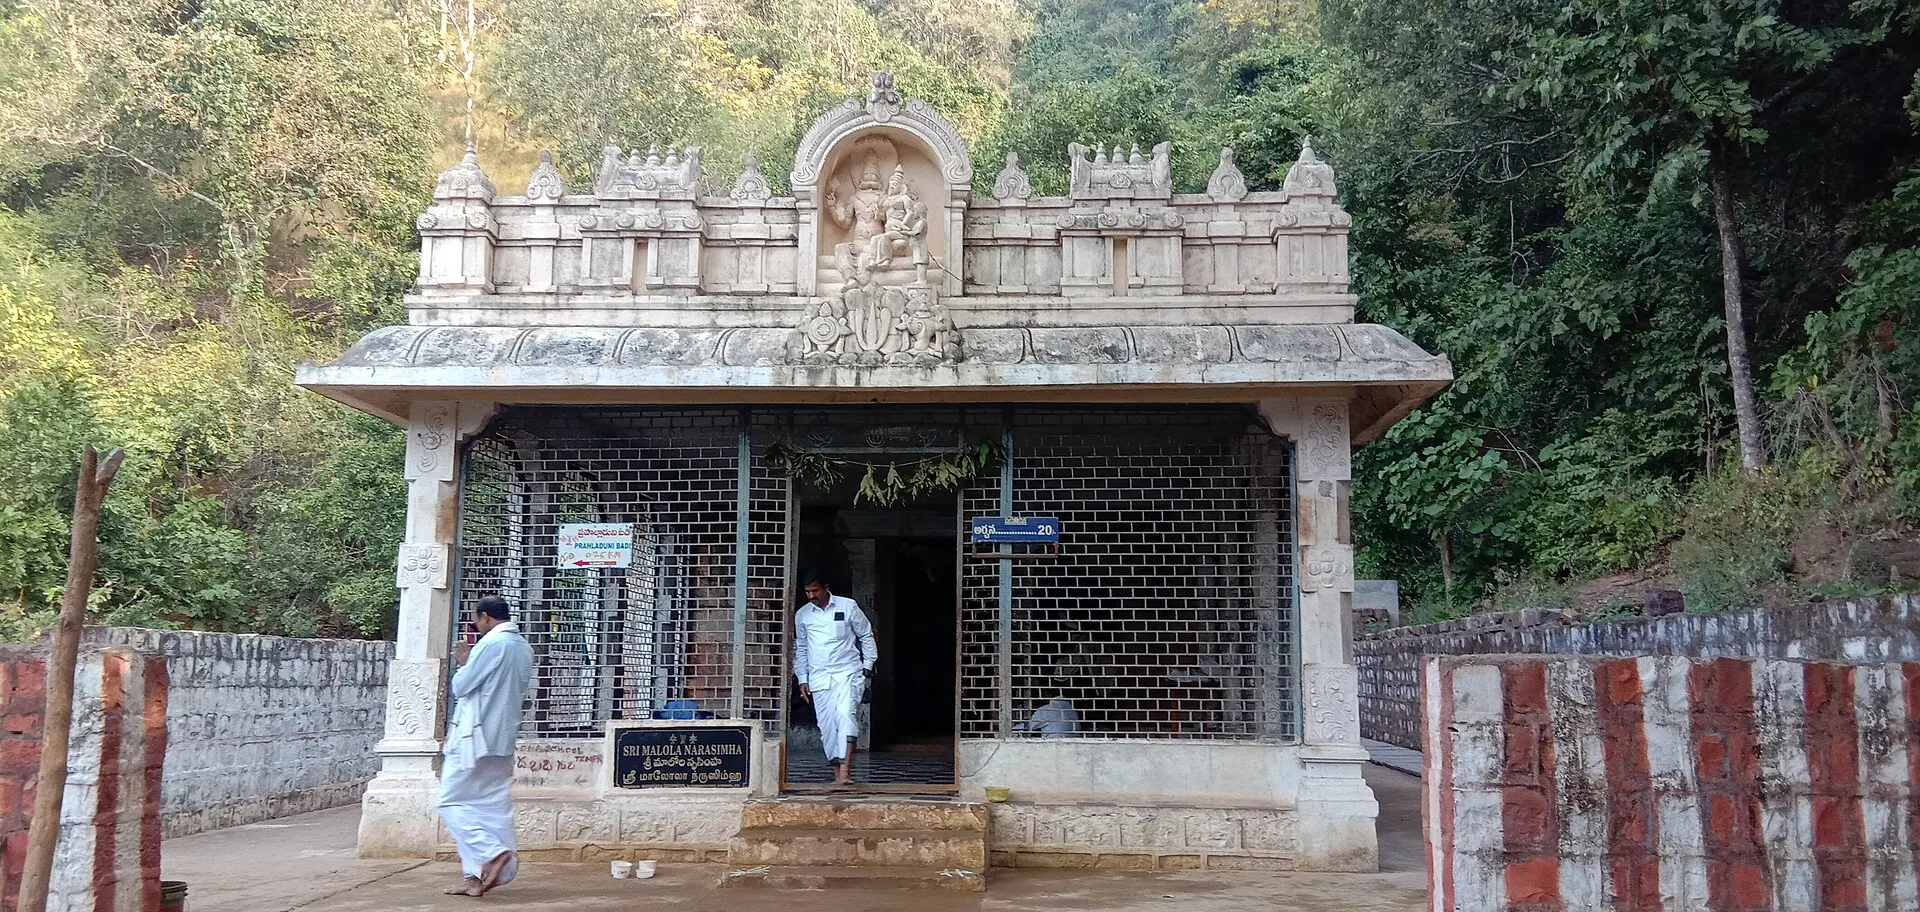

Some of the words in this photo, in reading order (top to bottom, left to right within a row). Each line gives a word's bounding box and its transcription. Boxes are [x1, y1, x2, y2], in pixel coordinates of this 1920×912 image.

[623, 745, 640, 757] SRI
[642, 745, 682, 756] MALOLA
[684, 744, 743, 756] NARASIMHA
[643, 756, 653, 770] శ్రీ
[653, 755, 686, 767] మాలోల
[640, 770, 688, 781] மாலோலா
